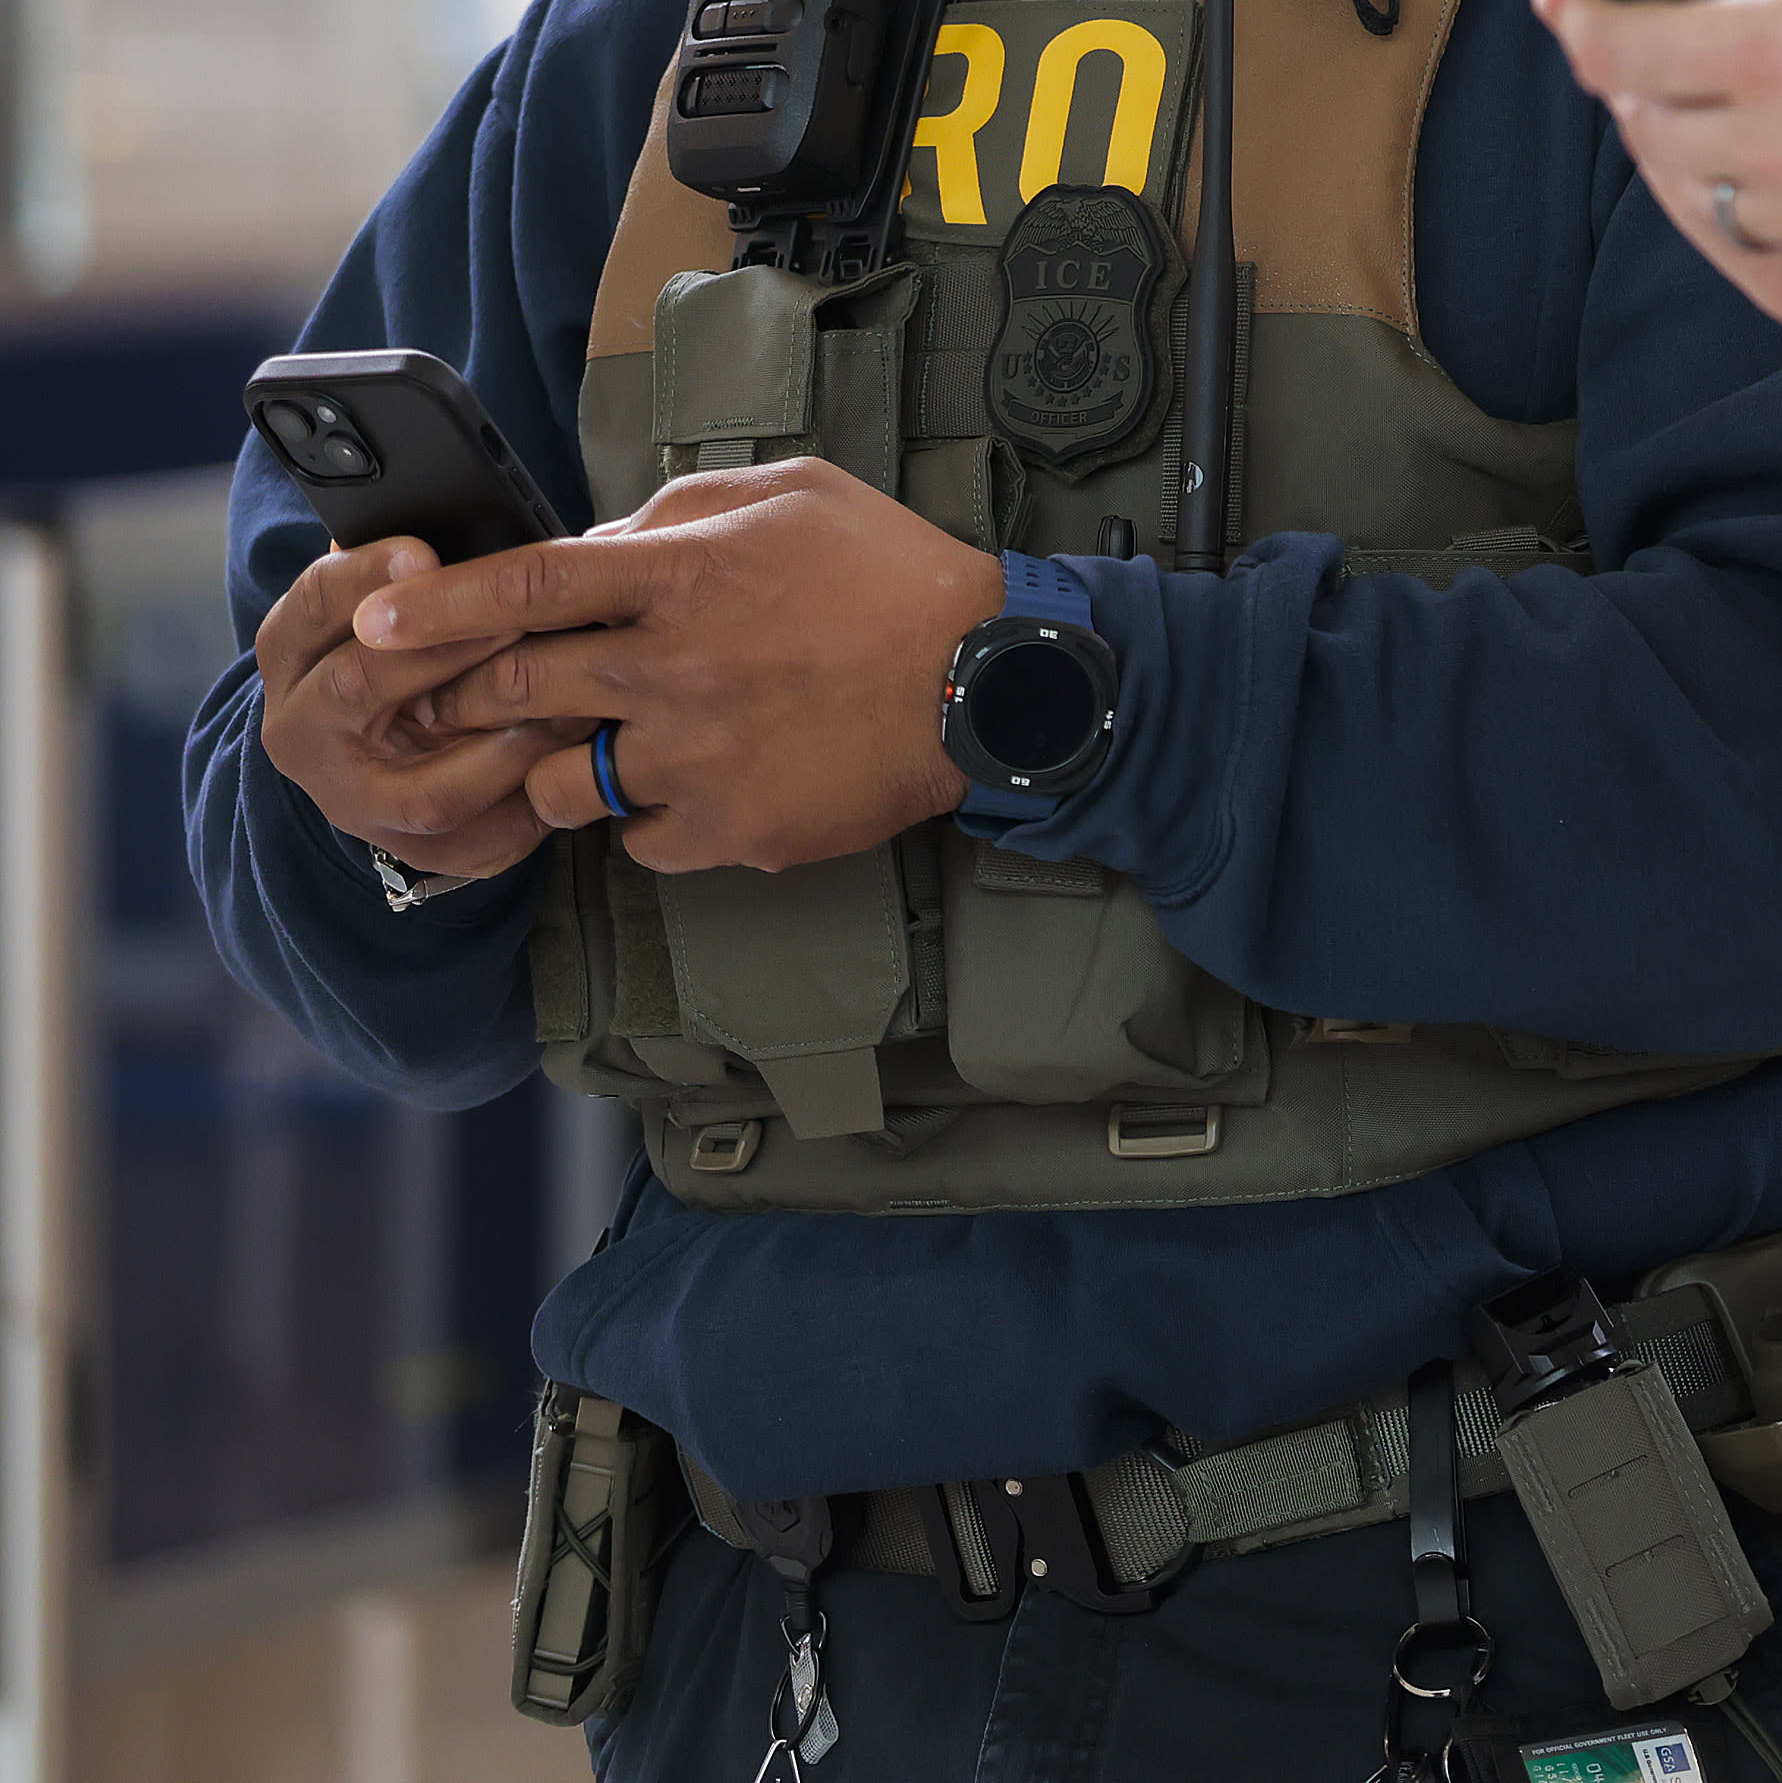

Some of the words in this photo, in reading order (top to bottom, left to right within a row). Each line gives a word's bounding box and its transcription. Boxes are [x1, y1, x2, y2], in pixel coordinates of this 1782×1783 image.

[899, 19, 1167, 225] RO
[1035, 260, 1112, 291] ICE
[1030, 410, 1089, 424] OFFICER
[1532, 1747, 1545, 1756] FOR
[1546, 1743, 1574, 1754] OFFICIAL
[1574, 1735, 1617, 1749] GOVERNMENT
[1617, 1733, 1636, 1741] FLEET
[1636, 1730, 1649, 1738] USE
[1650, 1726, 1667, 1735] ONLY
[1660, 1747, 1676, 1772] GSA
